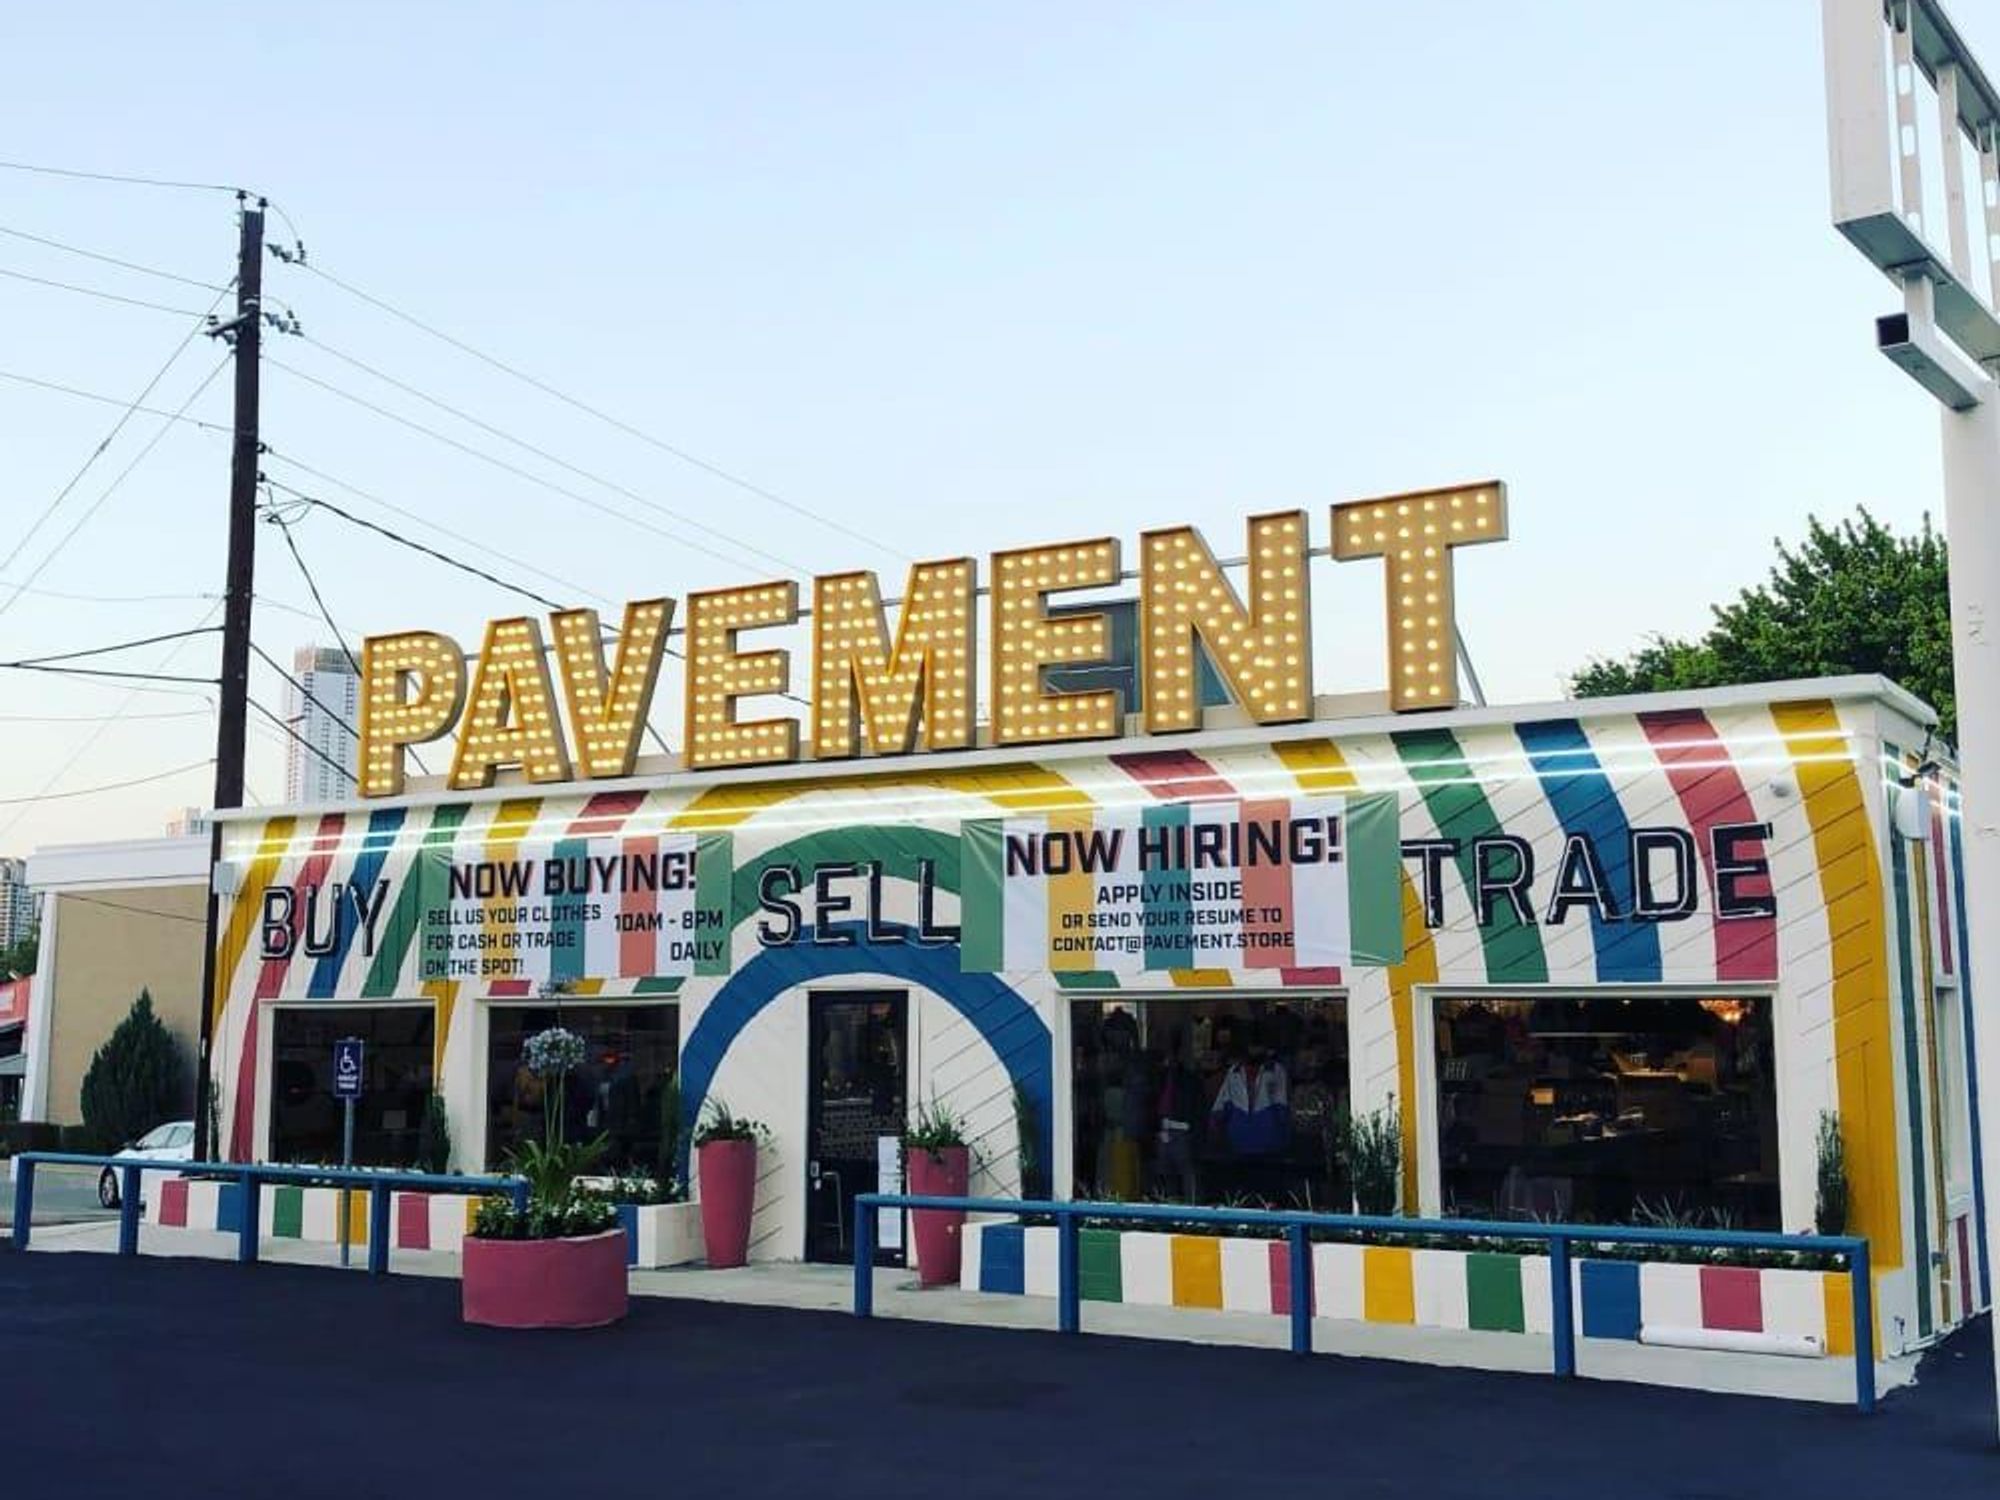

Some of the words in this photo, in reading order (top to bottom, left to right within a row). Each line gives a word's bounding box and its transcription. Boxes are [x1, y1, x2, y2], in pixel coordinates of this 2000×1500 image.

[359, 480, 1508, 799] PAVEMENT
[1006, 828, 1125, 877] NOW
[1138, 816, 1343, 872] HIRING!
[450, 861, 534, 899] NOW
[544, 851, 697, 896] BUYING!
[1401, 820, 1777, 929] TRADE
[757, 857, 961, 946] SELL
[1098, 884, 1162, 904] APPLY
[1169, 881, 1243, 902] INSIDE
[260, 879, 391, 961] BUY
[428, 907, 461, 925] SELL
[466, 908, 484, 924] US
[489, 906, 527, 923] YOUR
[532, 904, 602, 922] CLOTHES
[614, 912, 663, 932] 10AM
[682, 910, 723, 930] 8PM
[1062, 913, 1083, 929] OR
[1088, 911, 1131, 928] SEND
[1136, 910, 1180, 927] YOUR
[1184, 908, 1255, 925] RESUME
[1259, 907, 1282, 923] TO
[427, 933, 453, 951] FOR
[458, 932, 497, 950] CASH
[501, 932, 523, 949] OR
[526, 931, 576, 948] TRADE
[670, 942, 724, 961] DAILY
[1053, 931, 1295, 953] CONTACT@PAVEMENT.STORE
[426, 958, 446, 975] ON
[450, 958, 479, 975] THE
[482, 957, 524, 975] SPOT!
